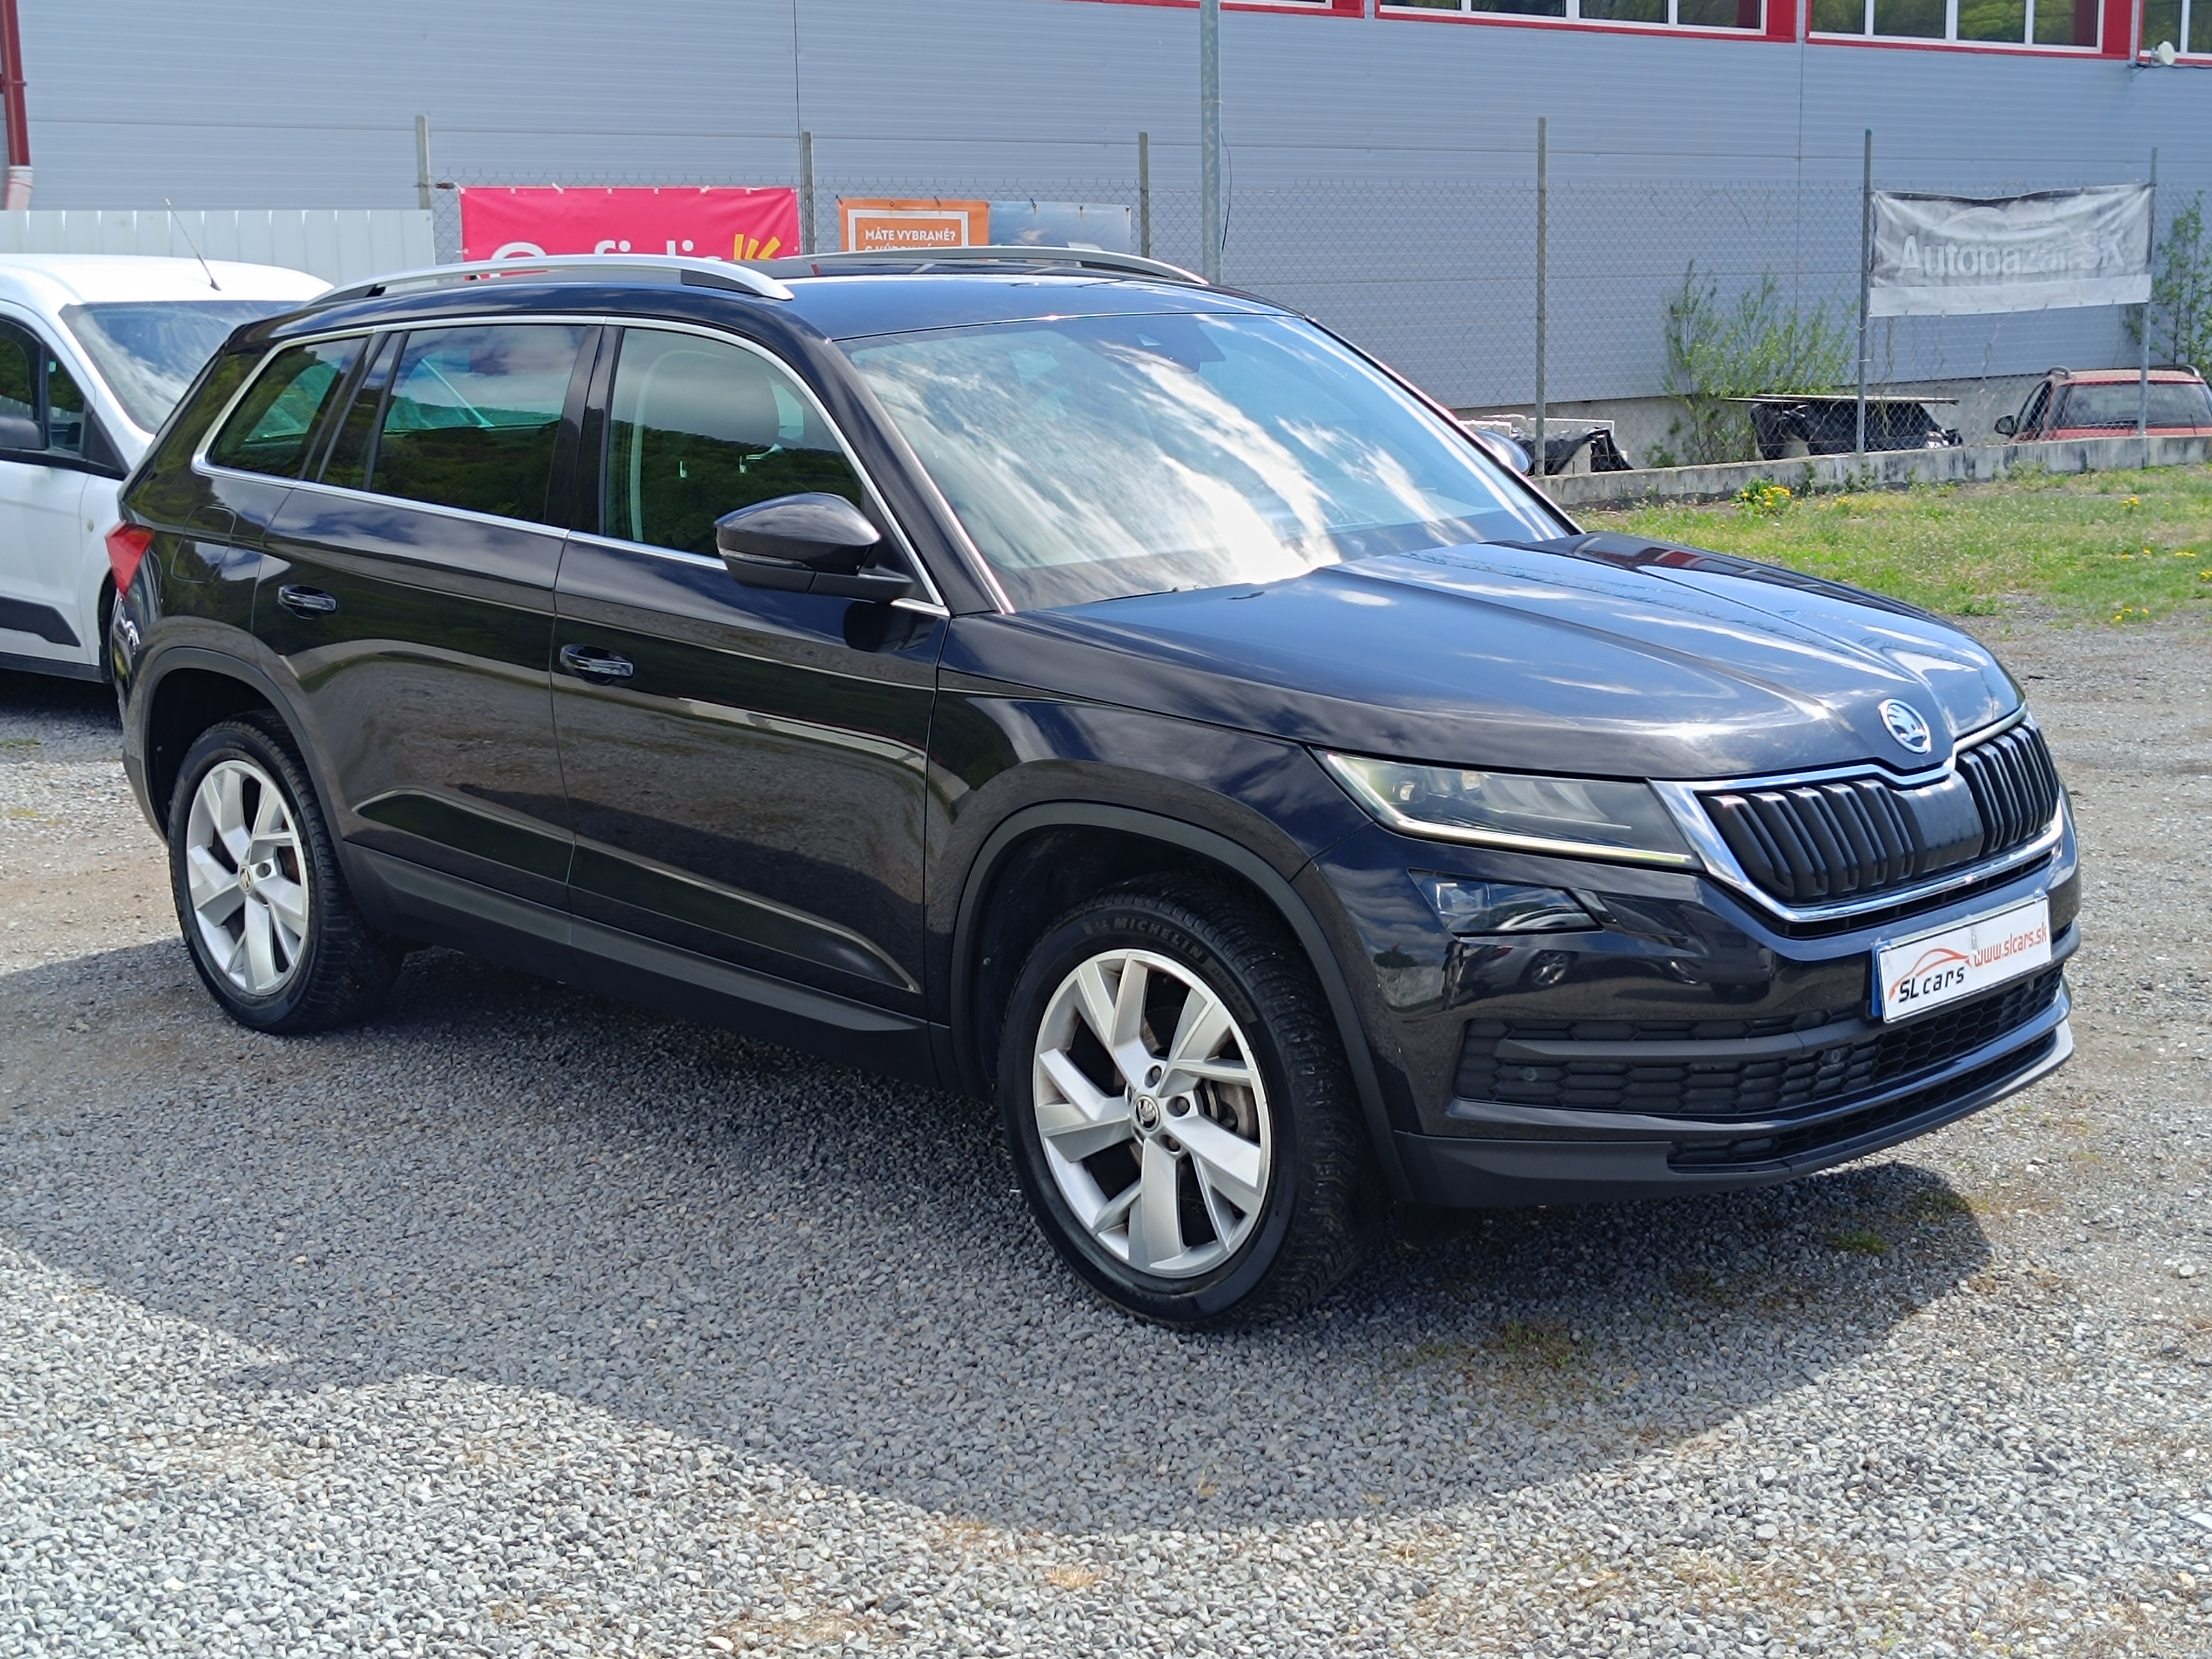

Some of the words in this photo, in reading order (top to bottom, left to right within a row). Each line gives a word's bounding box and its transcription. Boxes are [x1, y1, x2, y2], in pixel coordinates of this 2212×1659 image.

[865, 227, 894, 240] MÁTE
[896, 227, 956, 241] VYBRANÉ?
[1114, 918, 1204, 959] MICHELIN
[1974, 922, 2047, 967] www.slcars.sk
